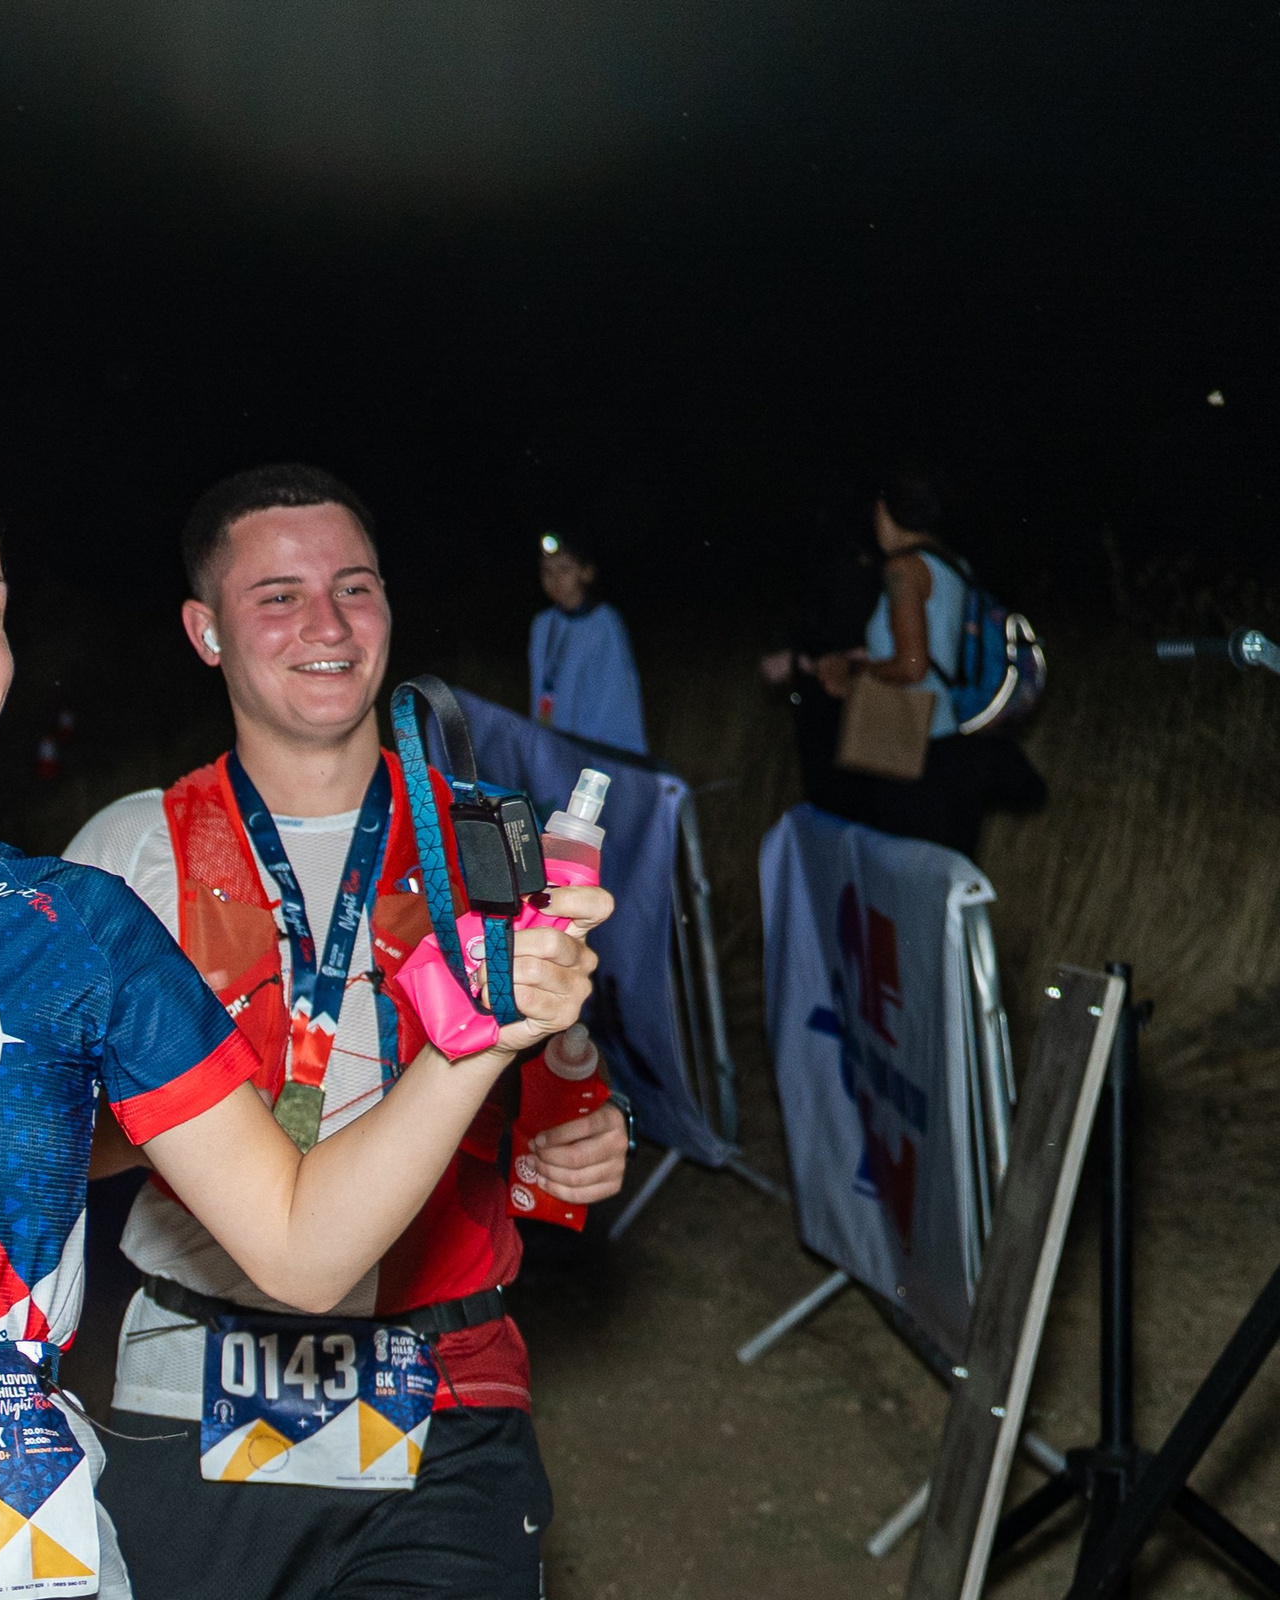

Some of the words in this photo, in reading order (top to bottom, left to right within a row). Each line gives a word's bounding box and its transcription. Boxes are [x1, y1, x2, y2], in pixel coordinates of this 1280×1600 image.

[222, 1332, 359, 1400] 0143
[376, 1372, 395, 1388] 6K
[0, 1397, 34, 1421] Night
